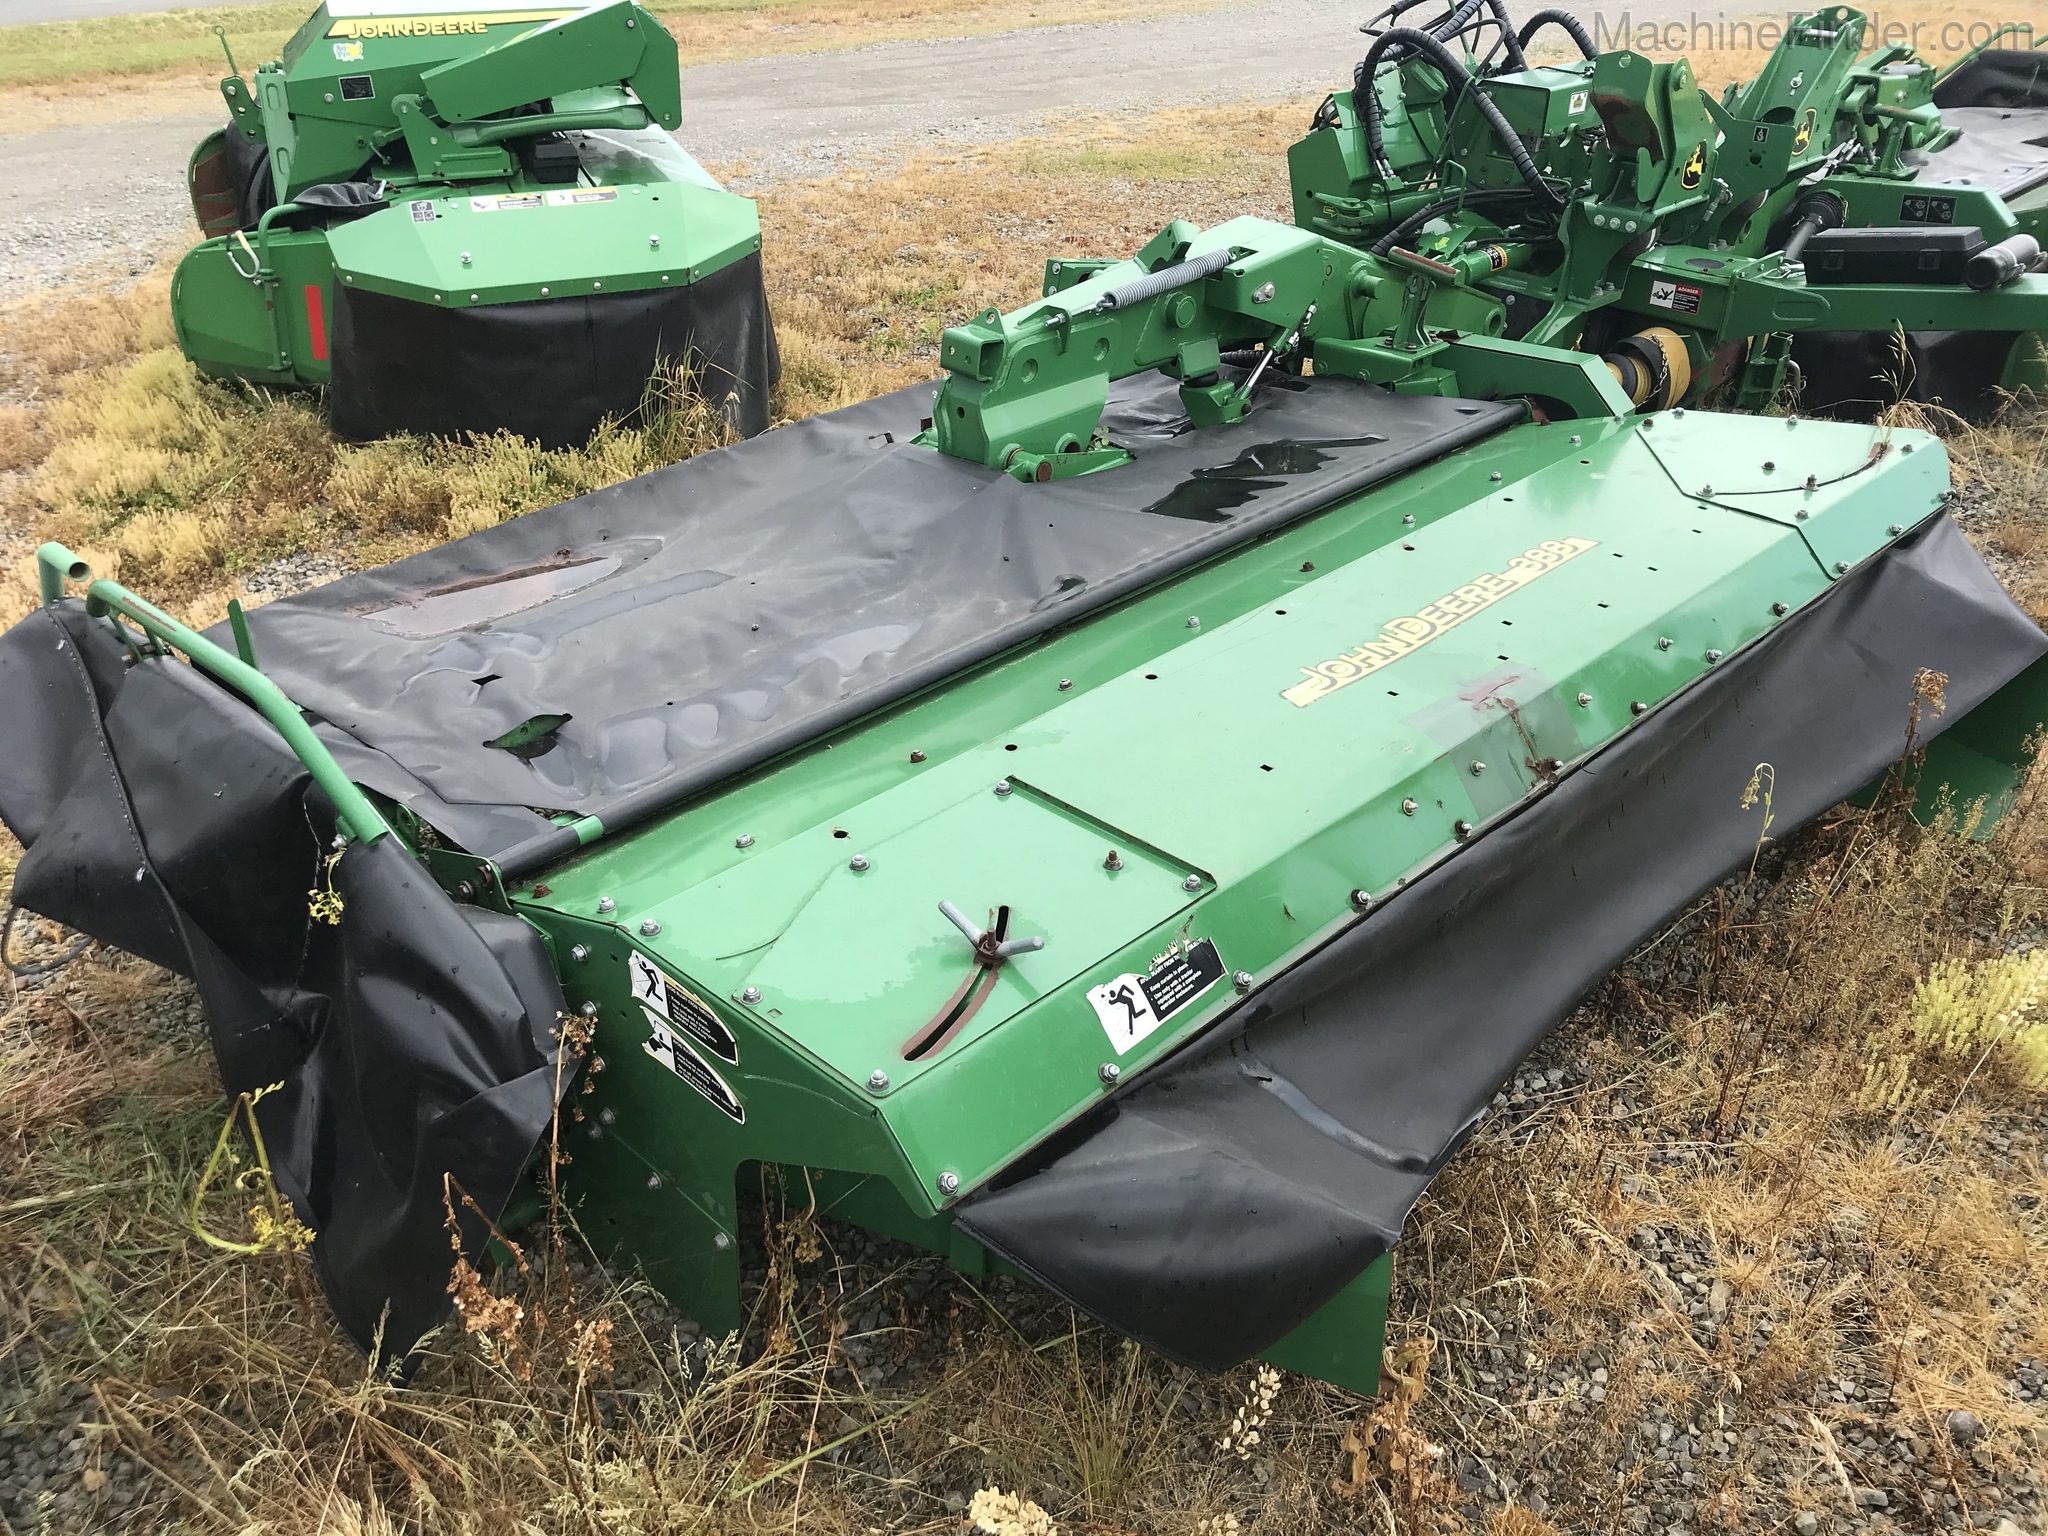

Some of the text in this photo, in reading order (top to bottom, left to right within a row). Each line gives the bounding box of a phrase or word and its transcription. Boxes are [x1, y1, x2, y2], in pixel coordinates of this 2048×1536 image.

[348, 20, 489, 39] JOHN DEERE
[1298, 539, 1579, 691] JOHN DEERE 388
